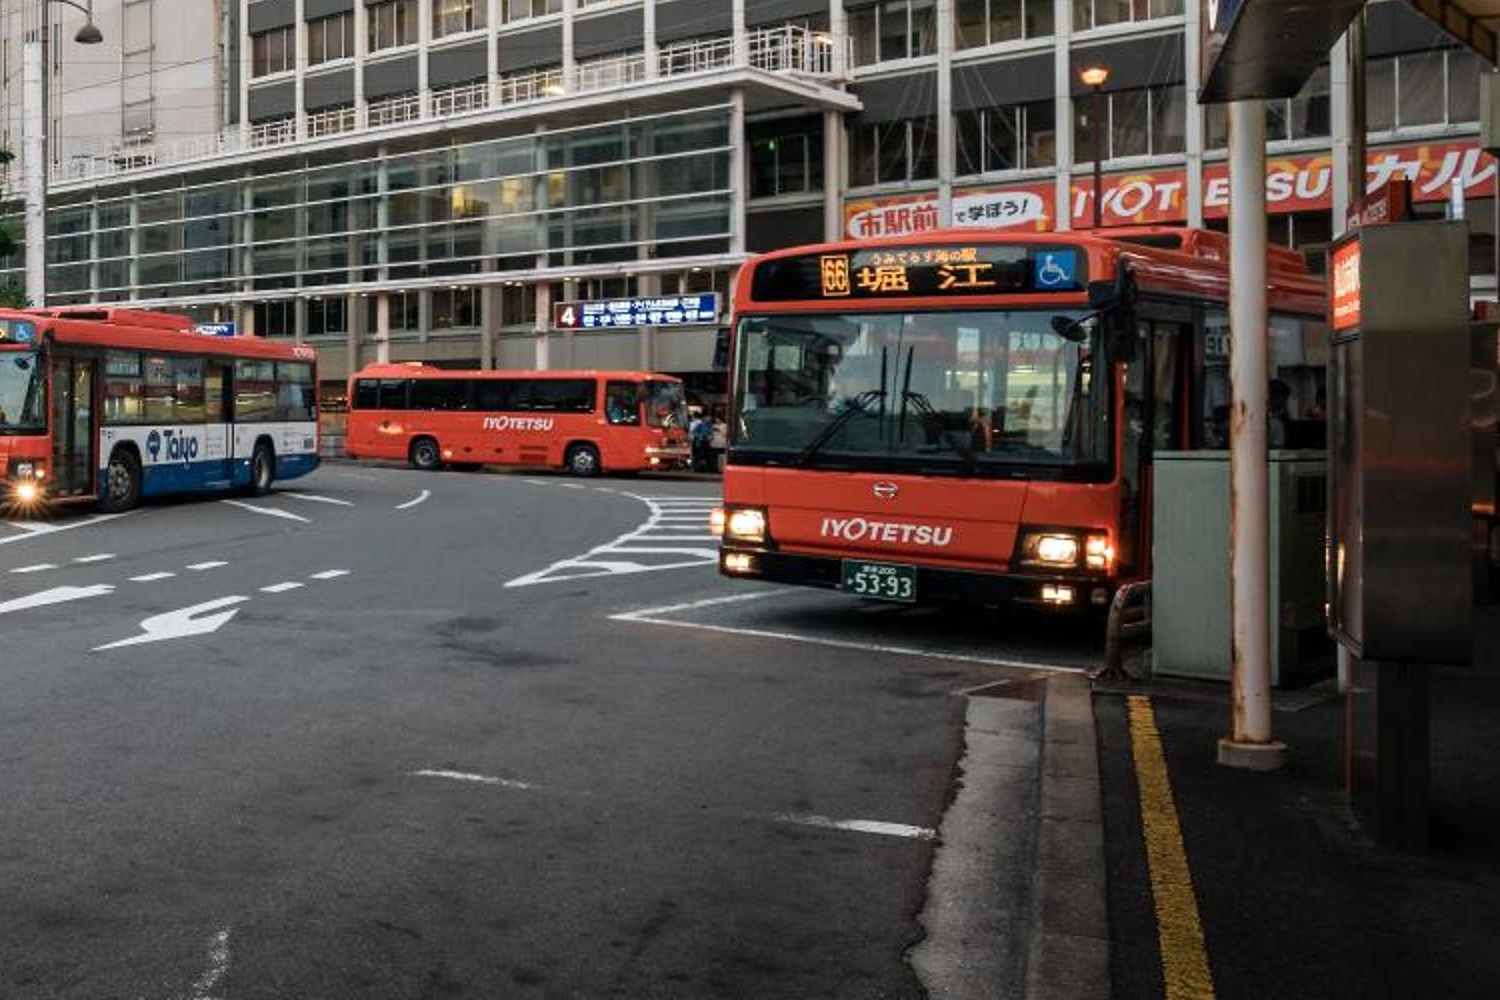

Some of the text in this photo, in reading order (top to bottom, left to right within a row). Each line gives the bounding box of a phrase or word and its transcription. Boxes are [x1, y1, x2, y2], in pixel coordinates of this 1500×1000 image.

[1072, 166, 1333, 218] IYOTESU
[825, 258, 846, 292] 66
[856, 263, 997, 292] 堀江
[560, 307, 576, 326] 4
[483, 415, 554, 431] IYOTETSU
[163, 429, 199, 470] Taiyo
[820, 518, 953, 546] IYOTETSU
[854, 573, 912, 597] 53-93
